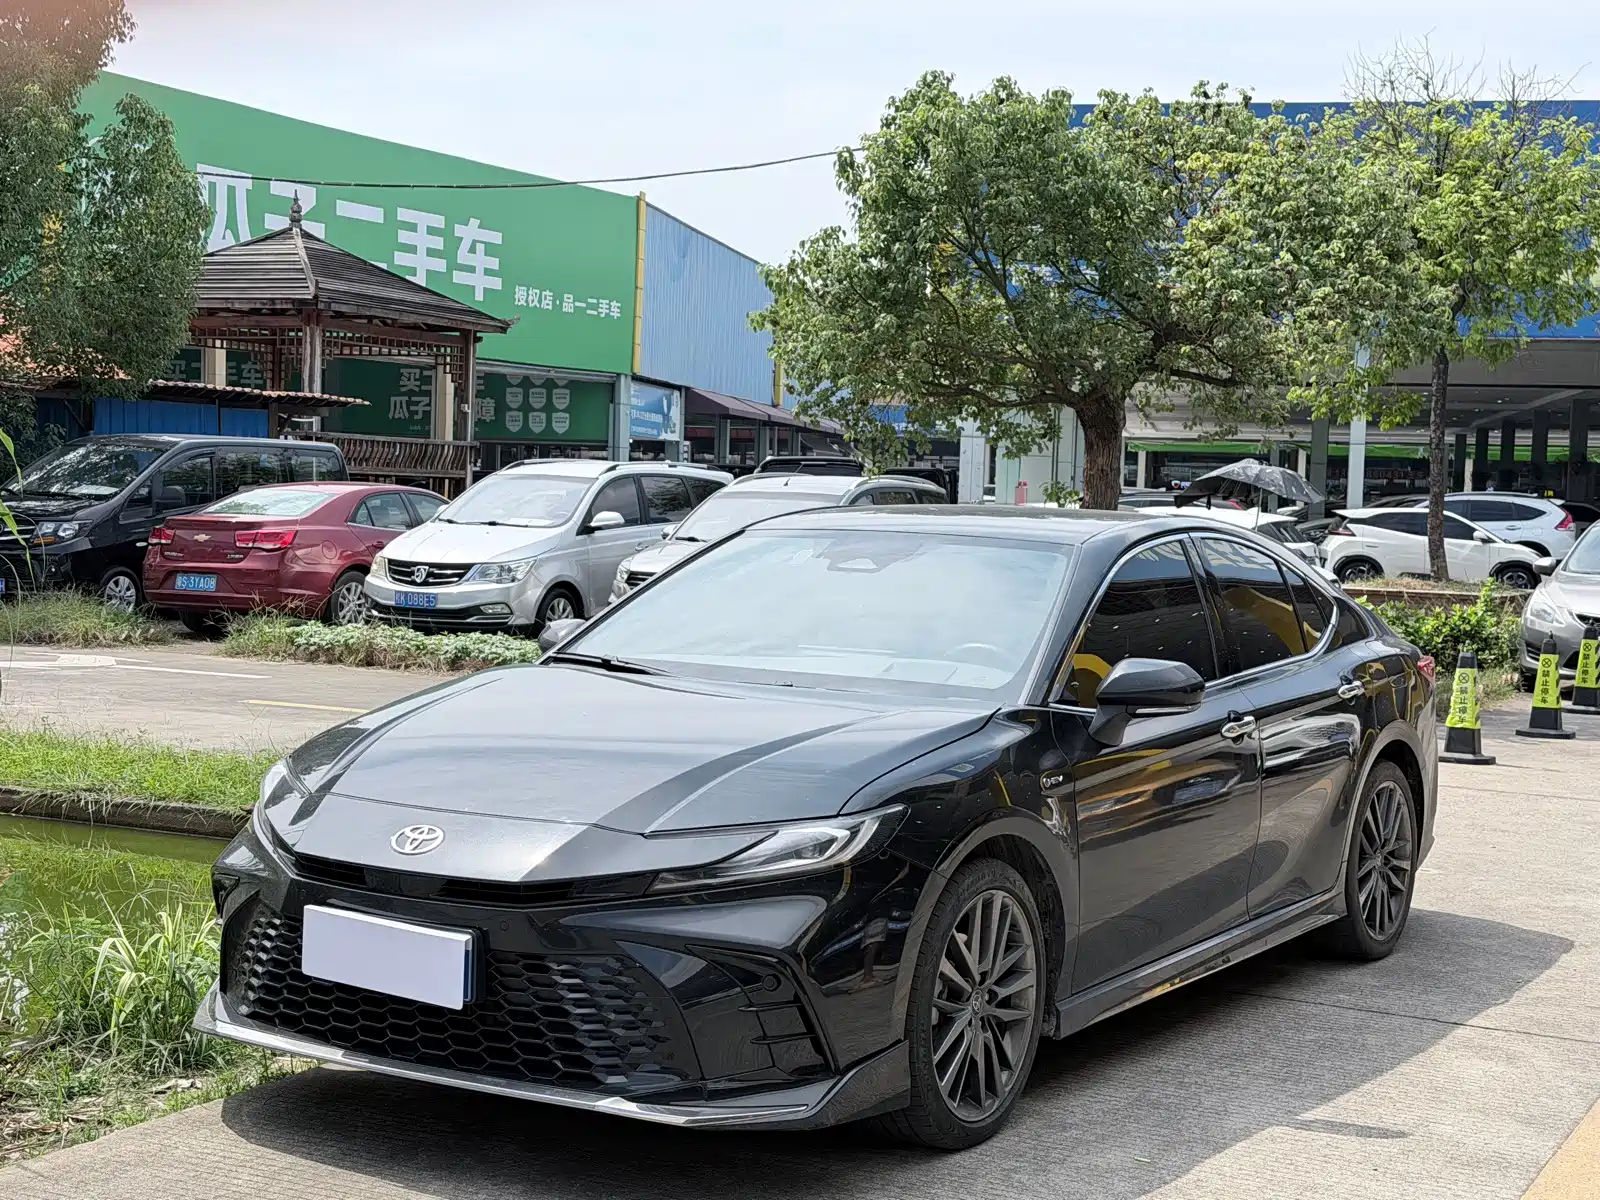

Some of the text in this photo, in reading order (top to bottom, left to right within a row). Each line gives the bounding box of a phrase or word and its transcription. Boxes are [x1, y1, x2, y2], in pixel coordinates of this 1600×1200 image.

[1457, 686, 1469, 724] 禁止停车
[1540, 670, 1551, 705] 禁止停车
